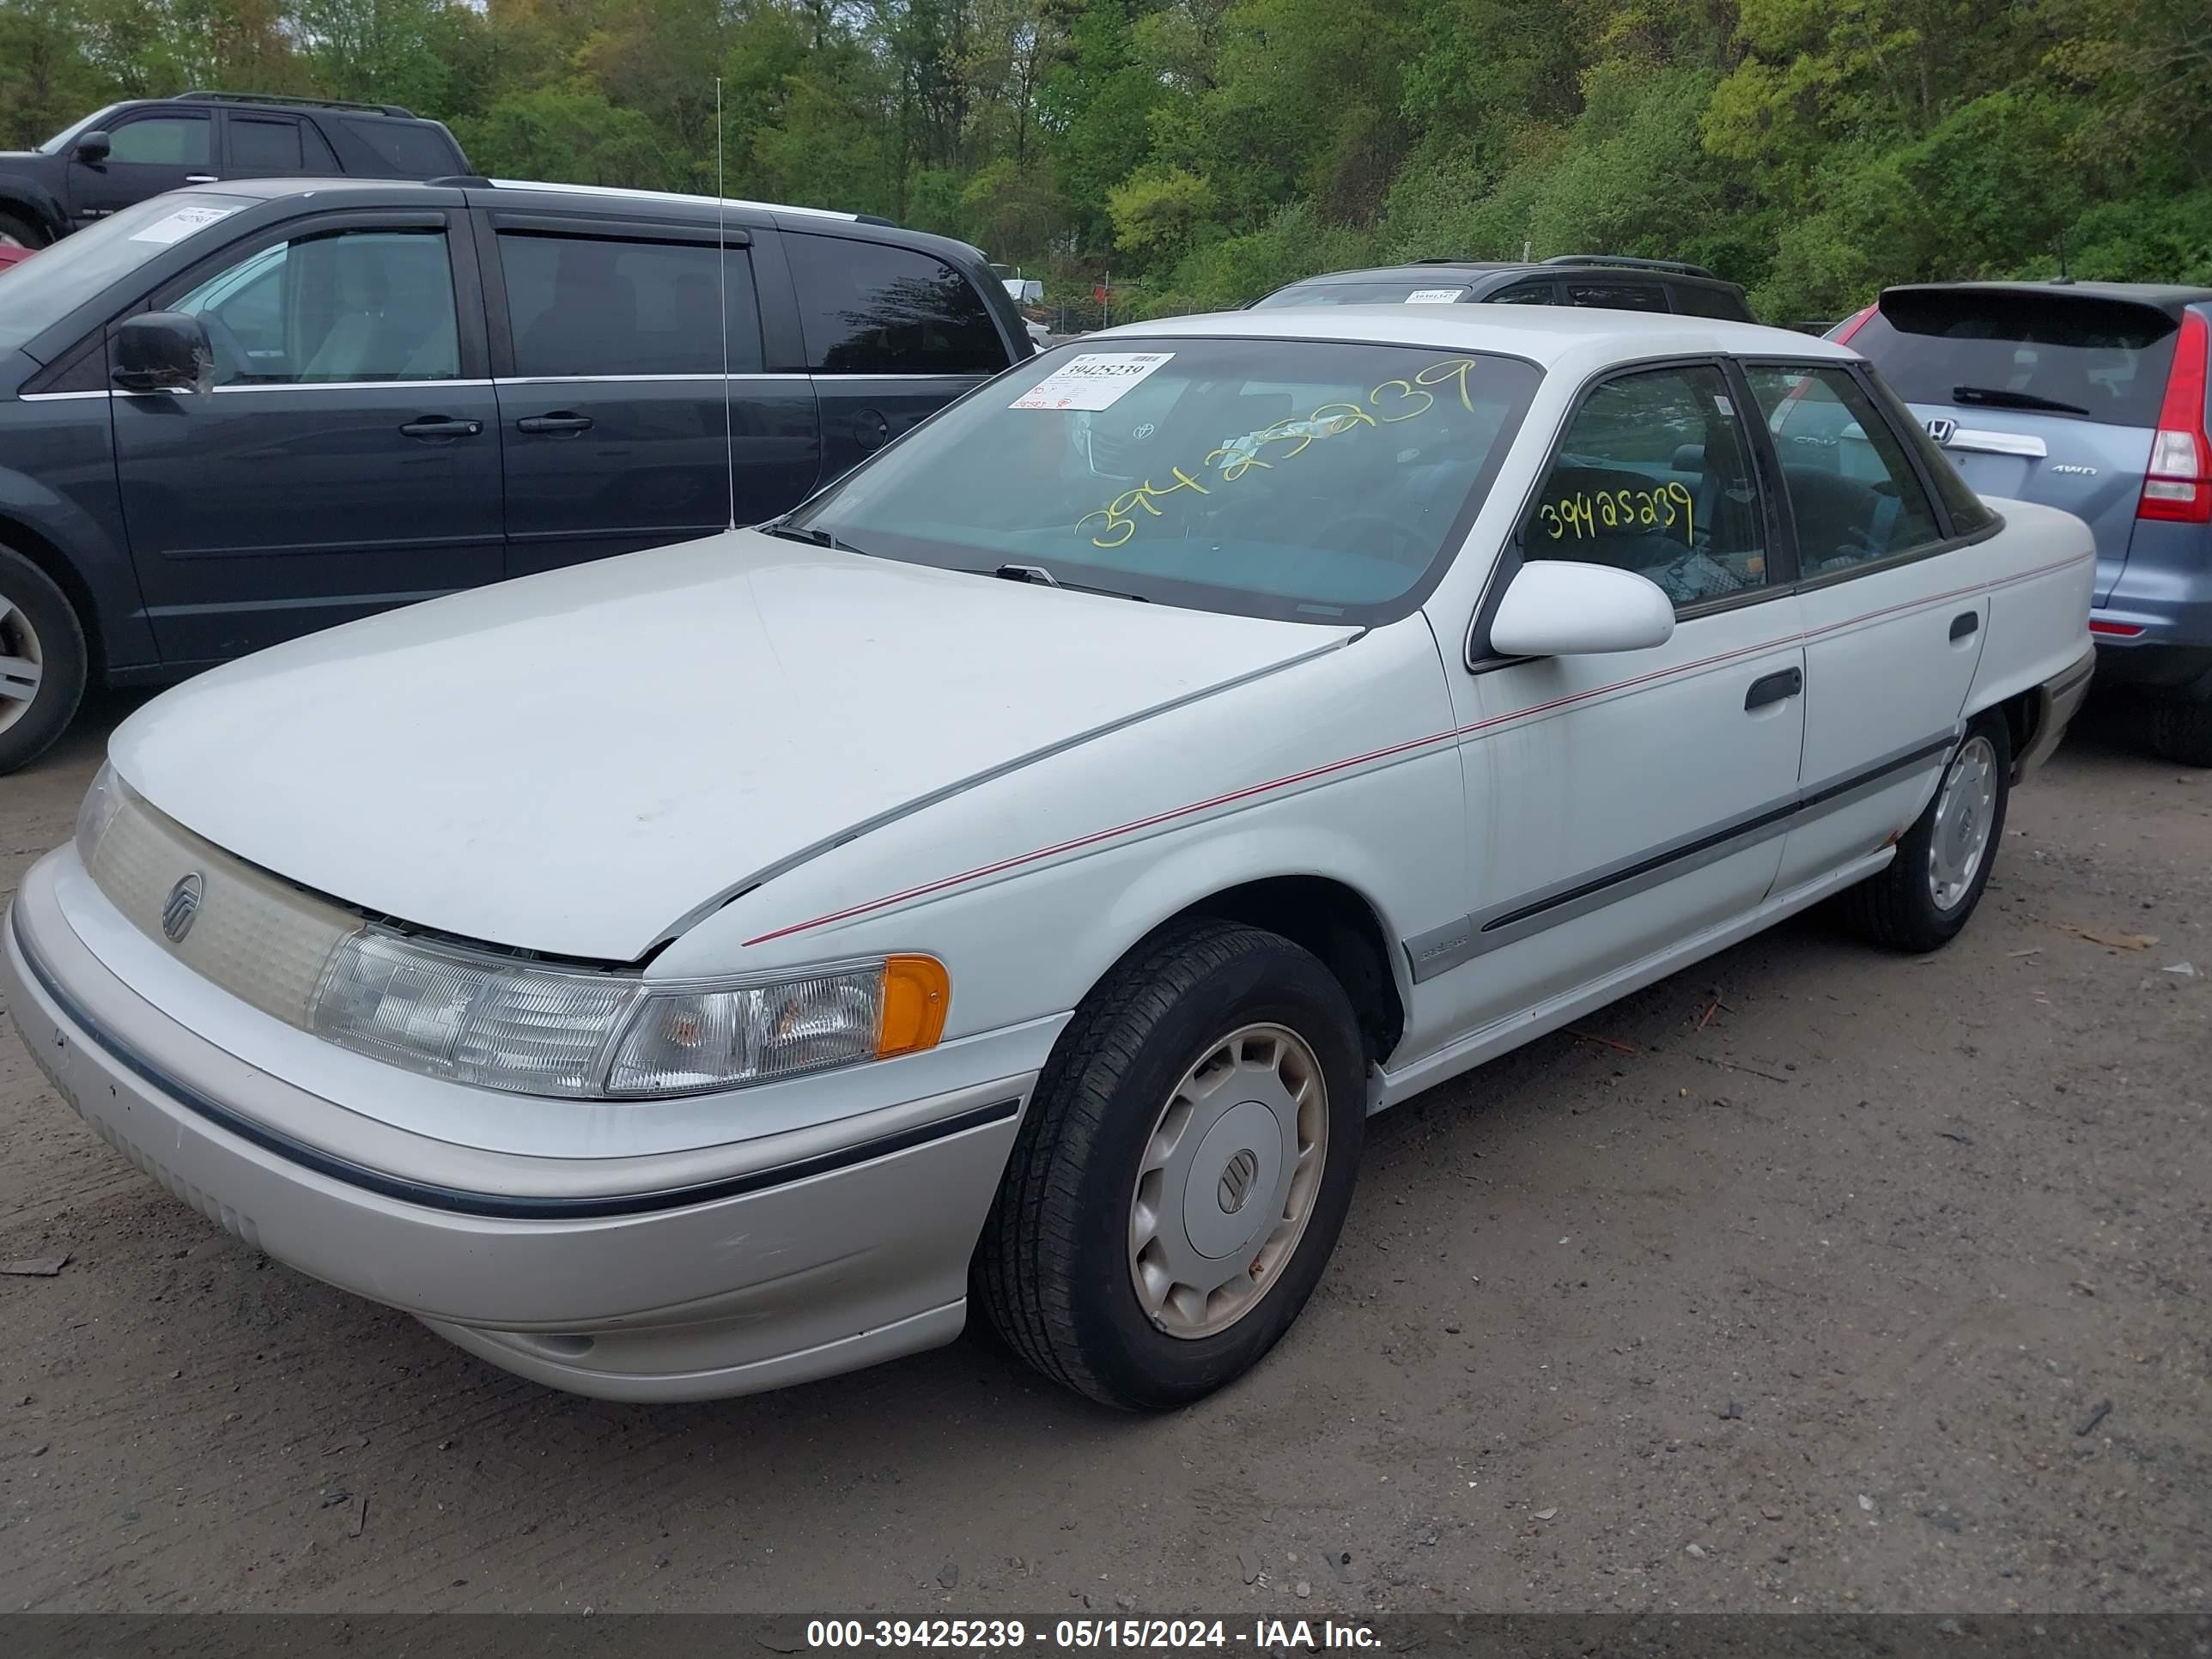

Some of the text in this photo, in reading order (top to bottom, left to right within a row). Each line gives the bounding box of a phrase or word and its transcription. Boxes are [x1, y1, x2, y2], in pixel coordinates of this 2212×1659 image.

[1061, 364, 1146, 376] 39425239
[2051, 465, 2098, 475] 4WD
[1540, 481, 1695, 546] 39425239
